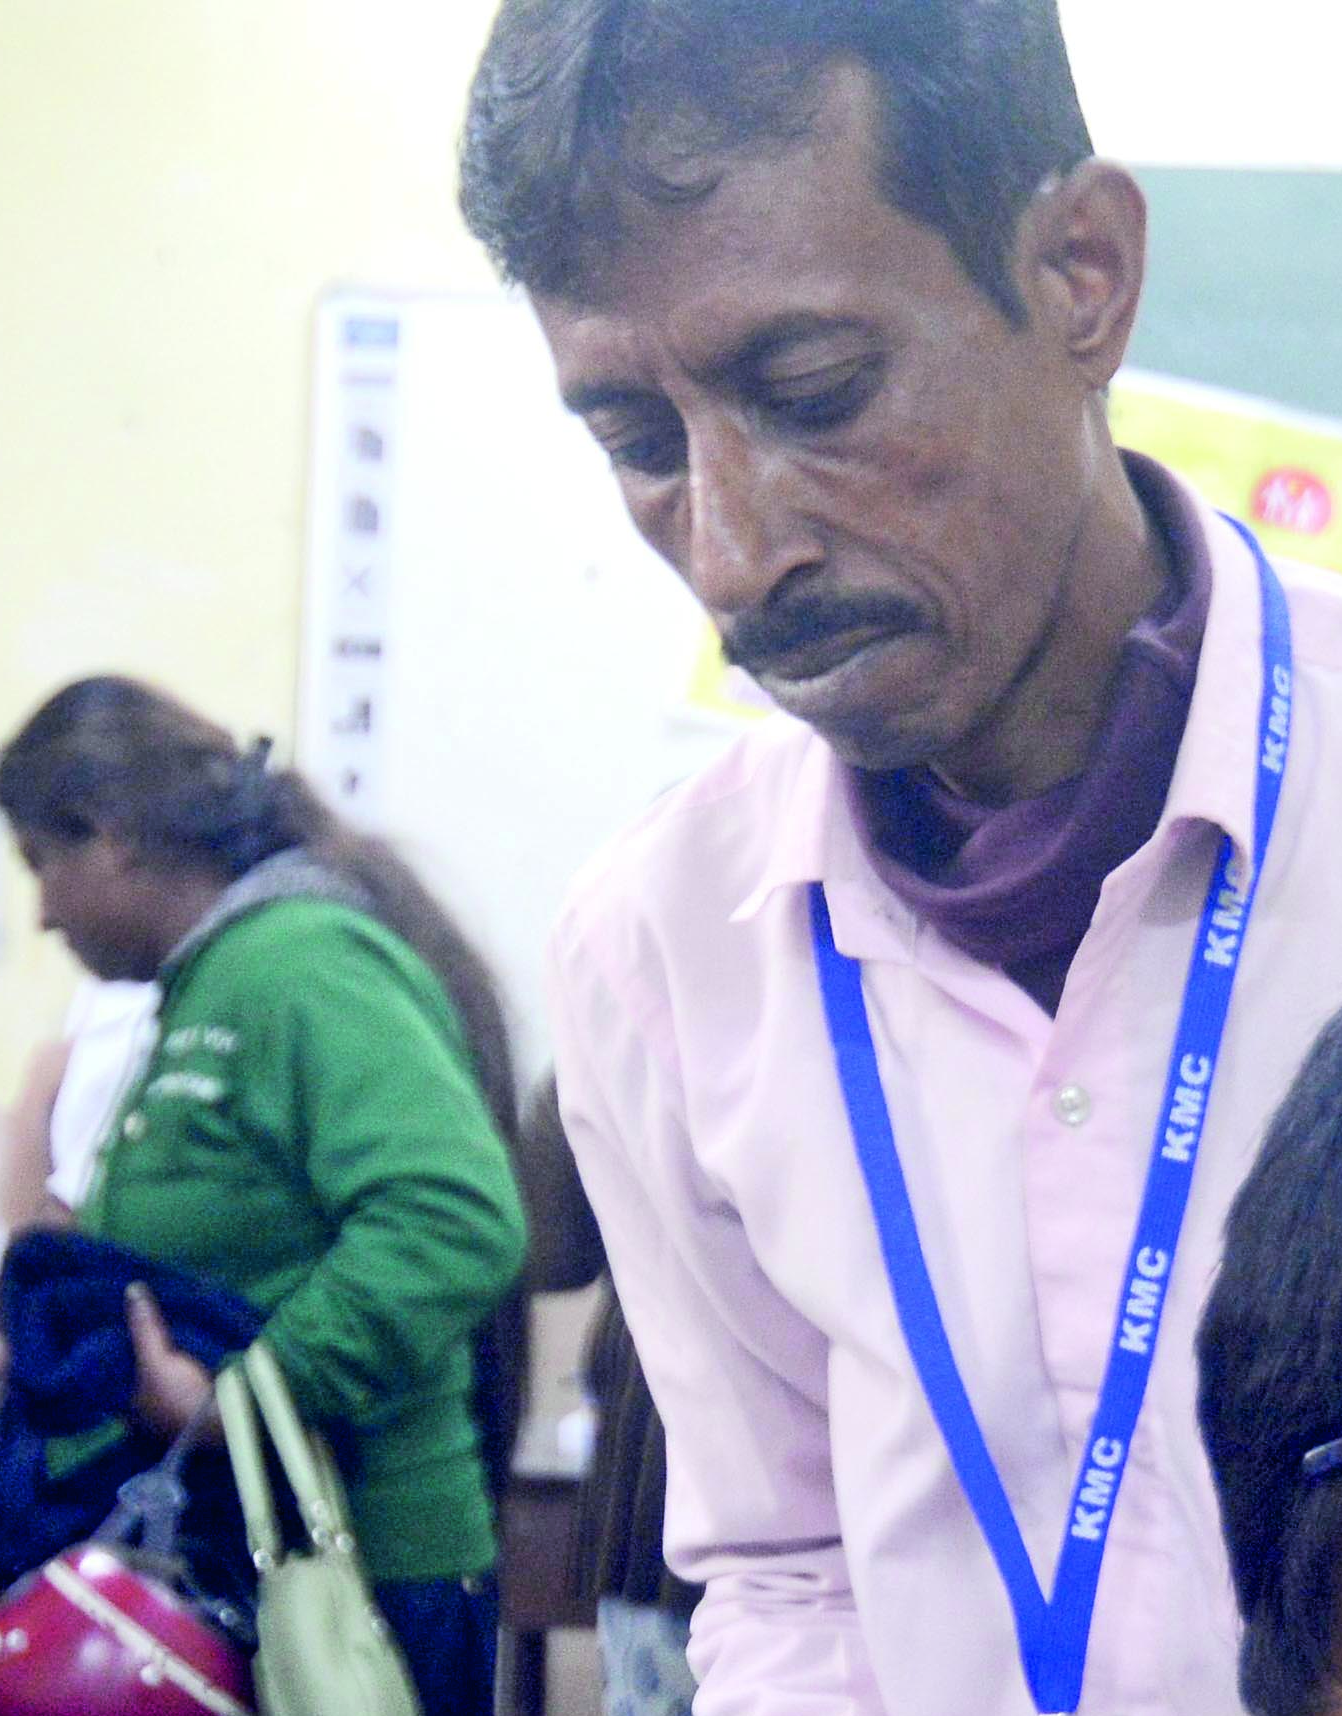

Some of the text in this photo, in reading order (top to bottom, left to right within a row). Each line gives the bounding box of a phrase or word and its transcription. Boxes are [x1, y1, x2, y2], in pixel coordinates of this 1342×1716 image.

[1262, 664, 1291, 773] KMC
[1162, 1053, 1210, 1162] KMC
[1119, 1246, 1168, 1354] KMC
[1071, 1436, 1122, 1540] KMC
